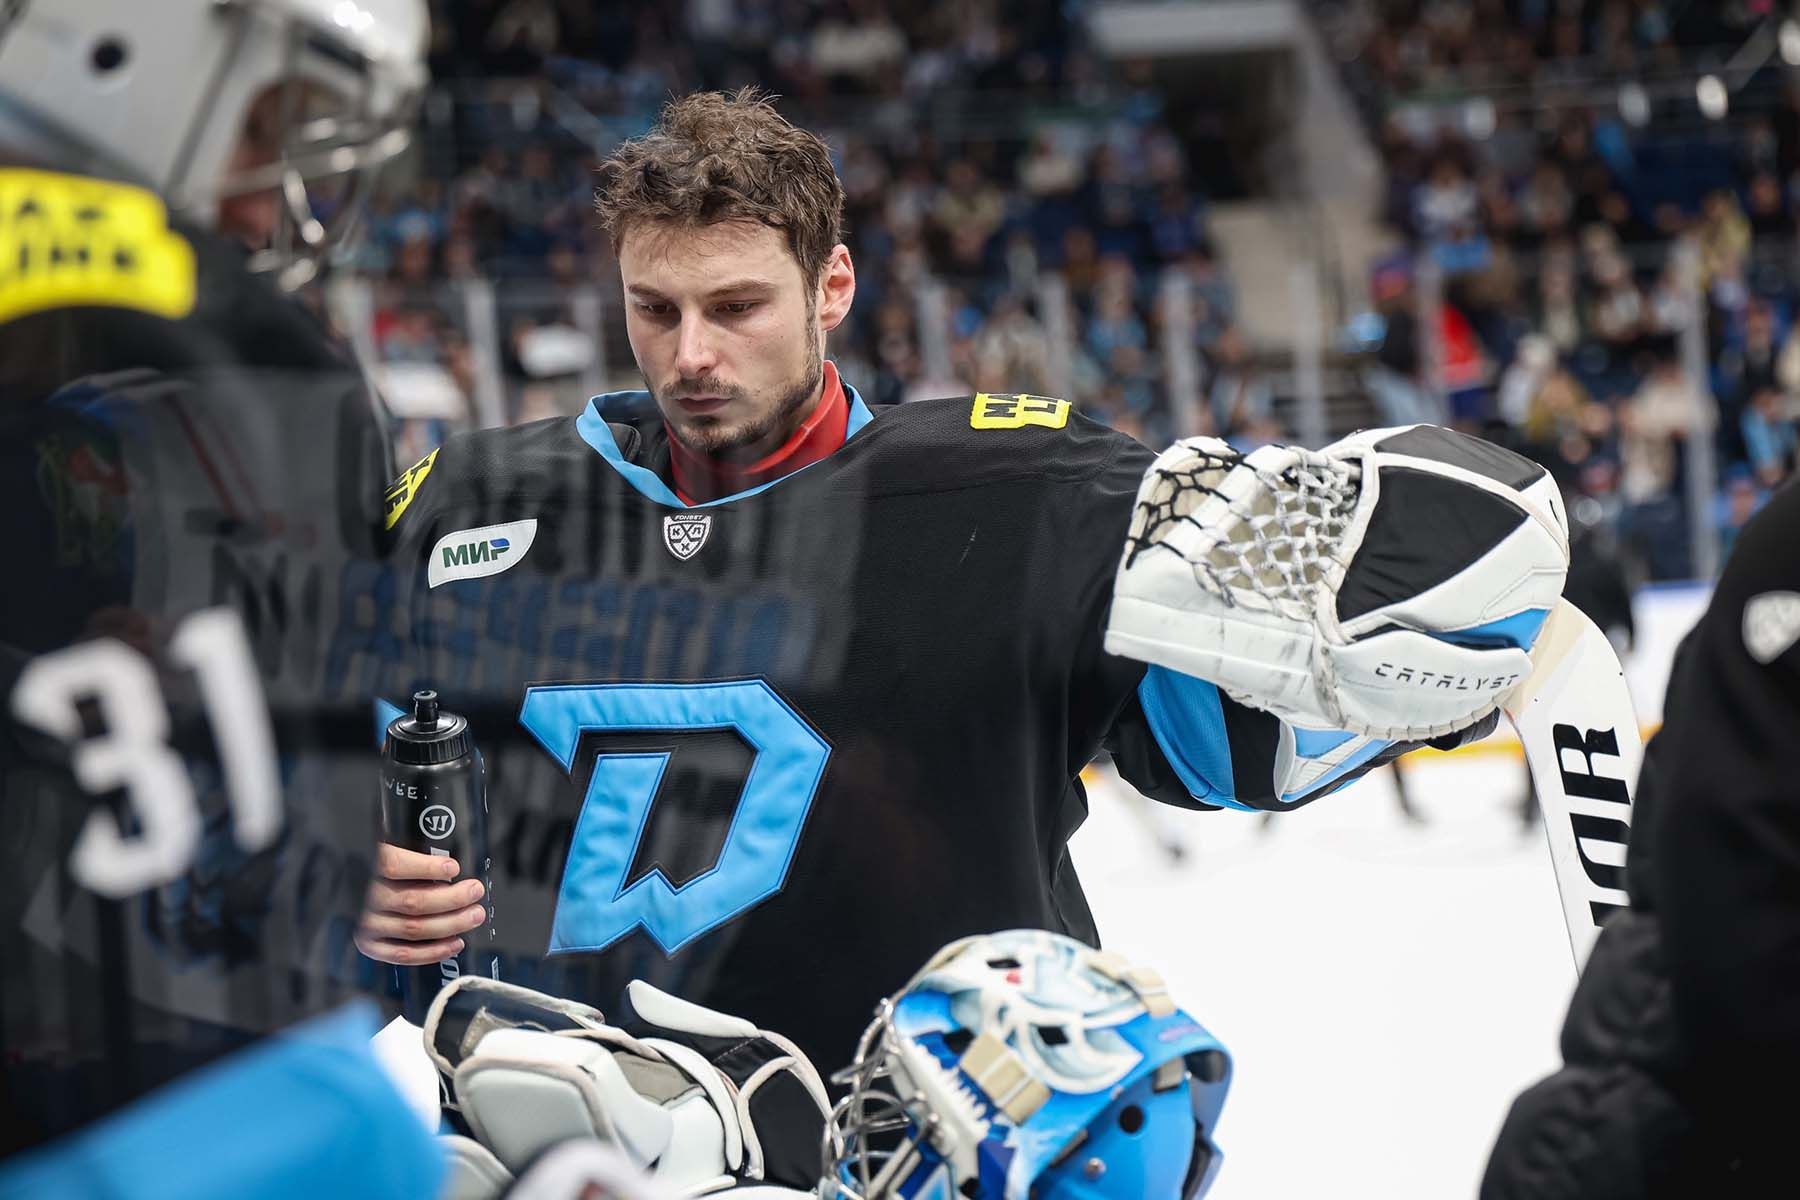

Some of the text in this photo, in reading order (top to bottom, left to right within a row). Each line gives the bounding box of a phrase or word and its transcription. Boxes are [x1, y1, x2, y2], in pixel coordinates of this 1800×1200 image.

[442, 538, 510, 568] МИР
[1375, 662, 1520, 690] CATALYST
[12, 605, 284, 898] 31
